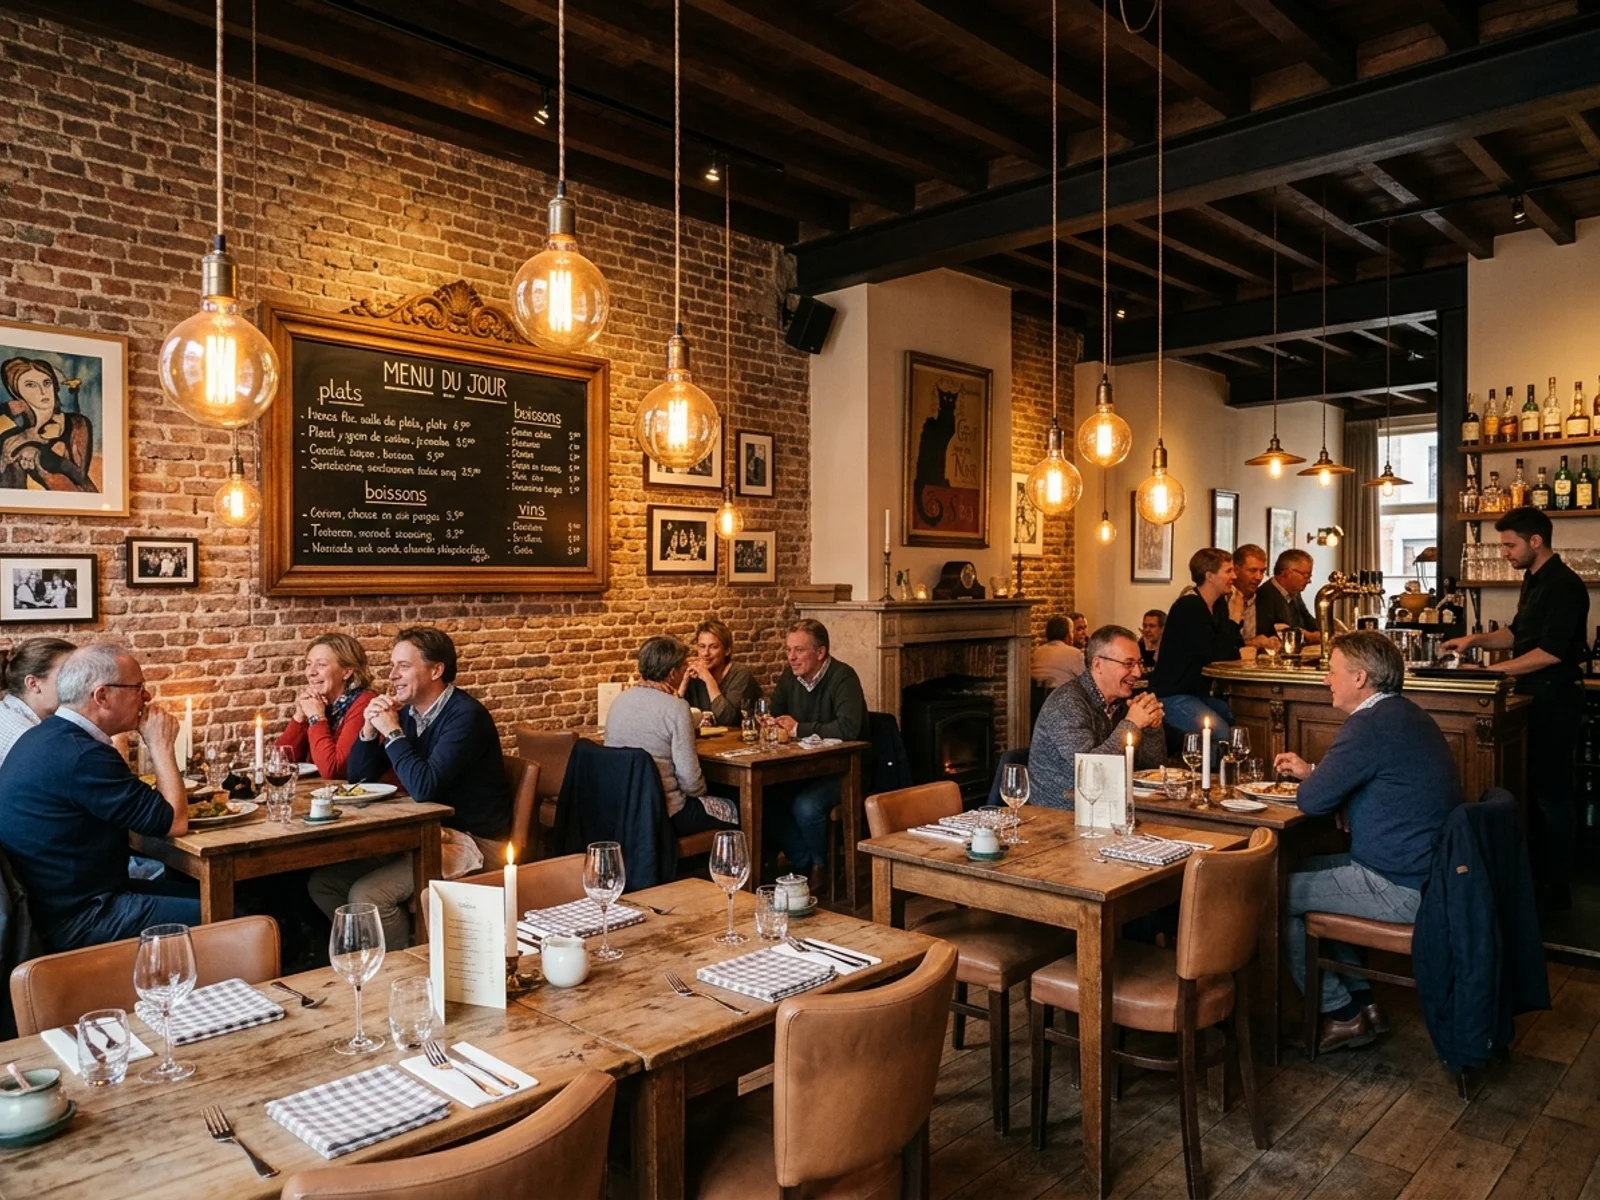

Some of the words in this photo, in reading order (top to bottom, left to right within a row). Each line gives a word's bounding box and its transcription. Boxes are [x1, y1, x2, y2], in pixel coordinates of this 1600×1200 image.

[319, 378, 363, 406] plats
[384, 361, 434, 388] MENU
[441, 369, 462, 391] DU
[467, 373, 508, 398] JOUR
[365, 480, 427, 502] boissons
[518, 501, 546, 517] vins
